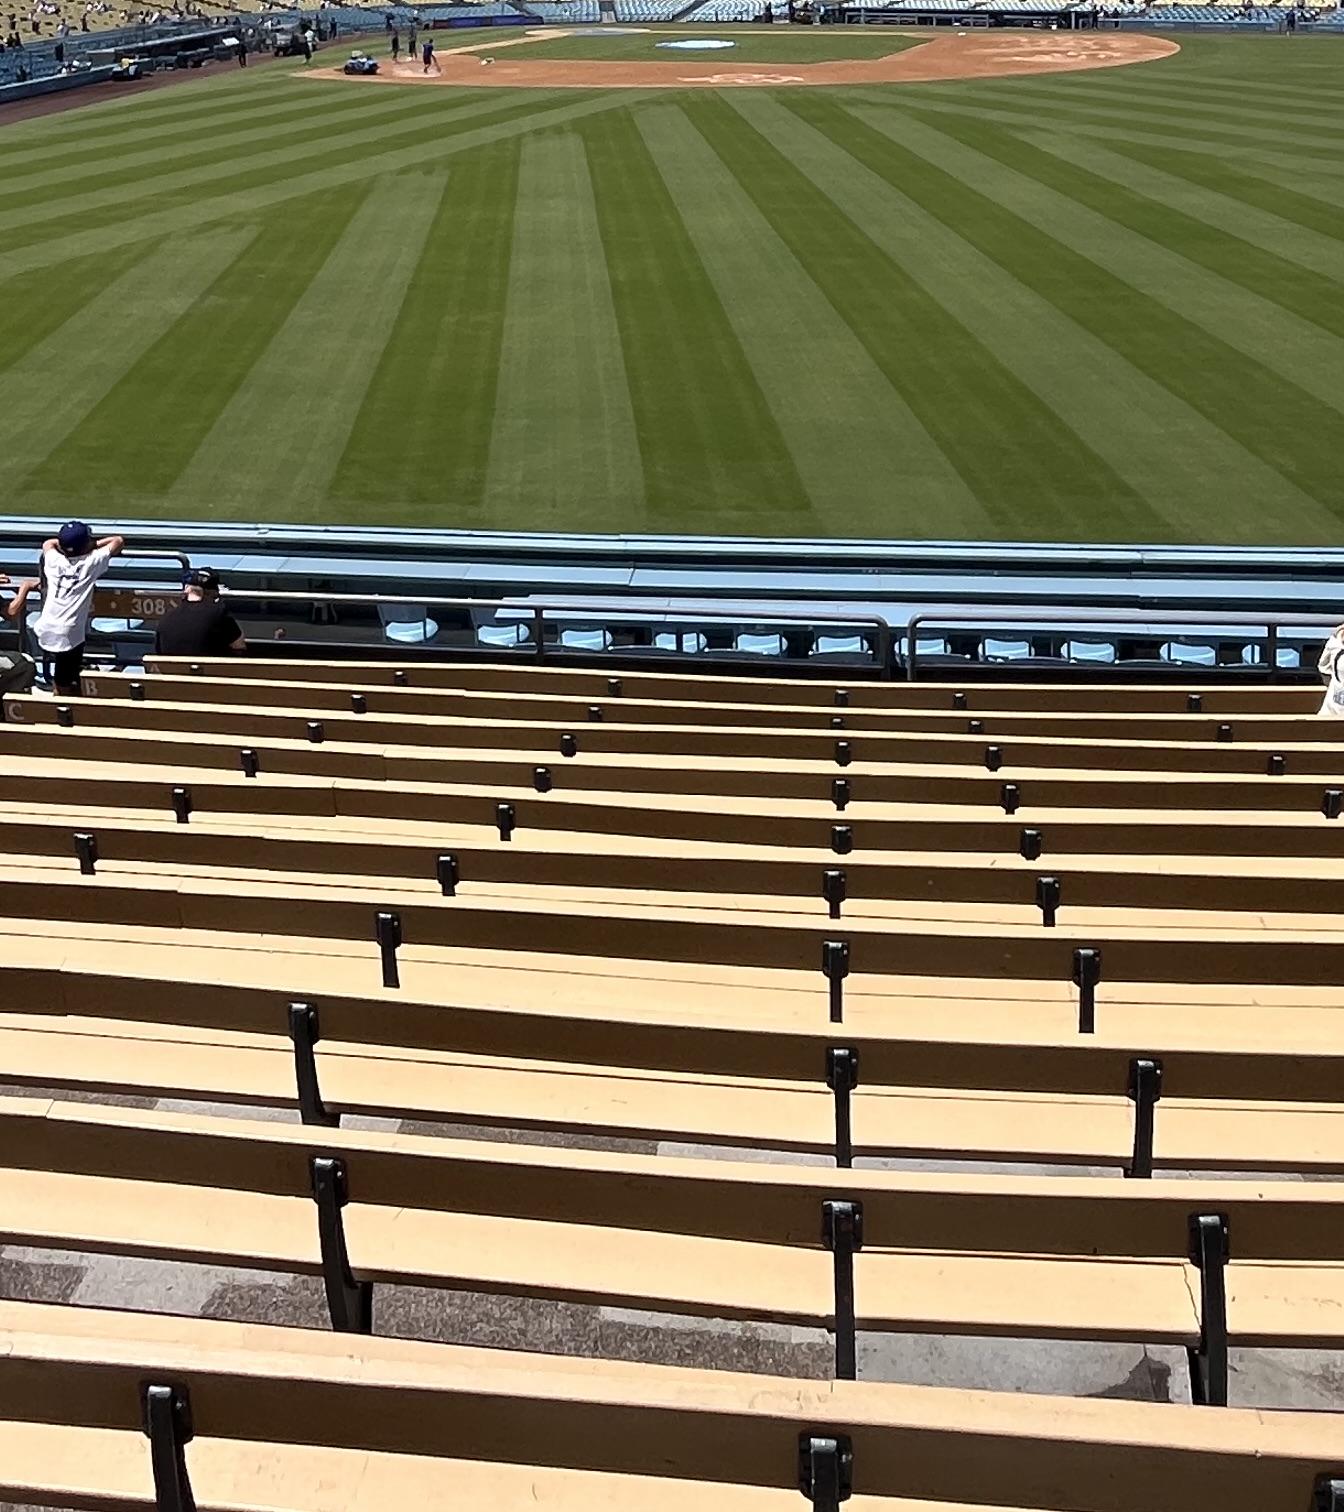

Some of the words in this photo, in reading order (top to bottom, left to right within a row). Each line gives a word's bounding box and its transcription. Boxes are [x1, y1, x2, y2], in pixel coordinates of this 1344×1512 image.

[131, 598, 165, 615] 308
[84, 680, 98, 695] B
[9, 704, 25, 720] C
